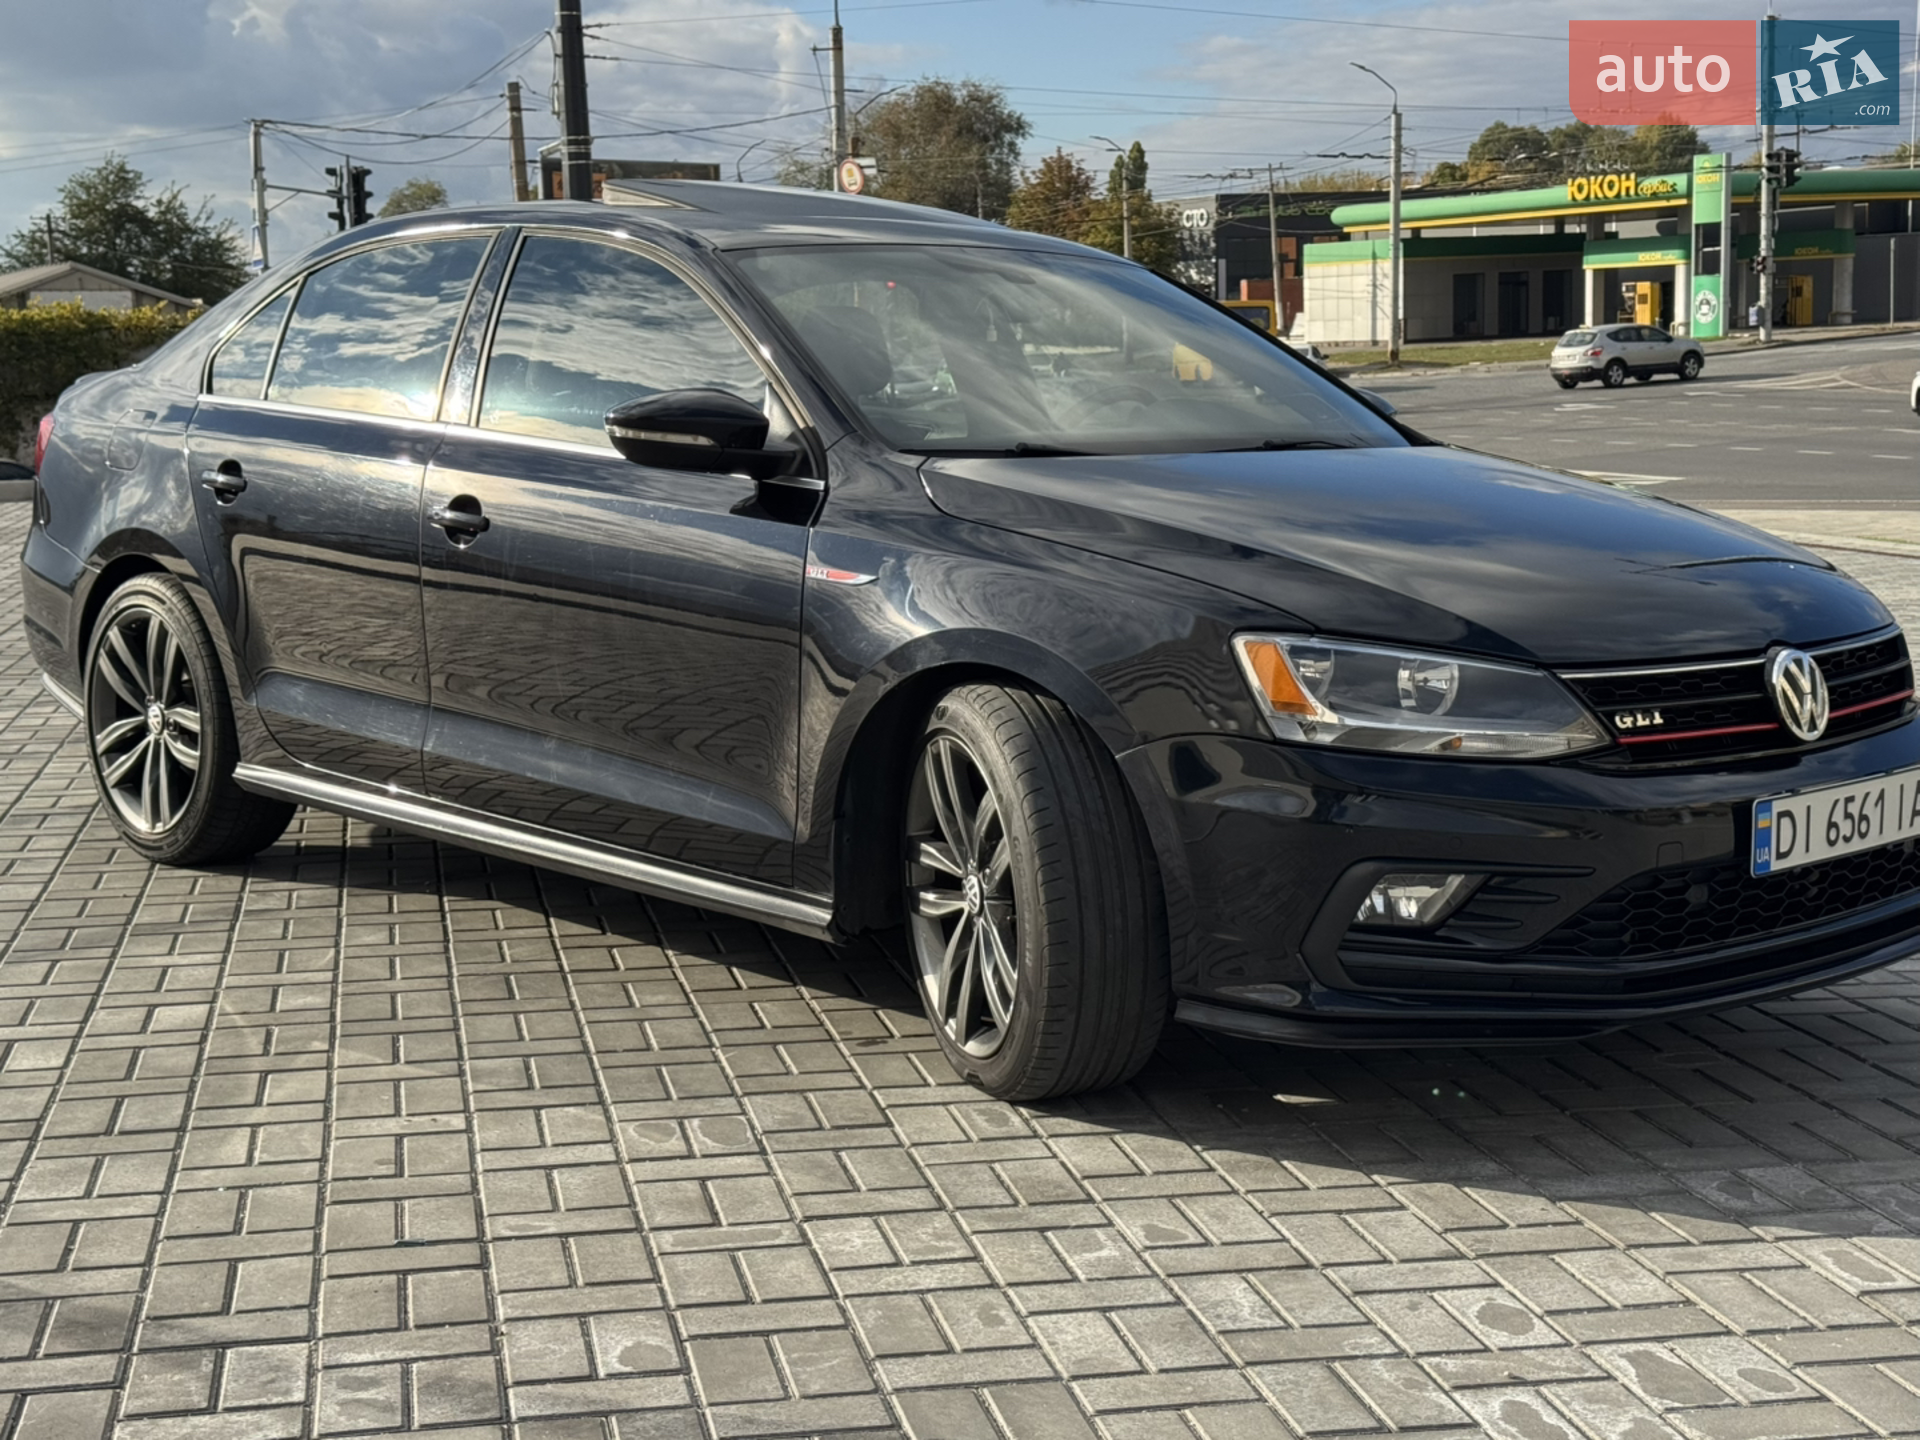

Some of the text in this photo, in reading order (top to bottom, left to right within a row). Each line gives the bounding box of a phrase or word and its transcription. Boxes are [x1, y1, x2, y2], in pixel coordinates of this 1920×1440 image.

[1567, 172, 1636, 201] ЮКОН
[1614, 708, 1664, 729] GLI
[1775, 804, 1811, 861] DI
[1826, 787, 1885, 848] 6561
[1756, 847, 1770, 863] UA
